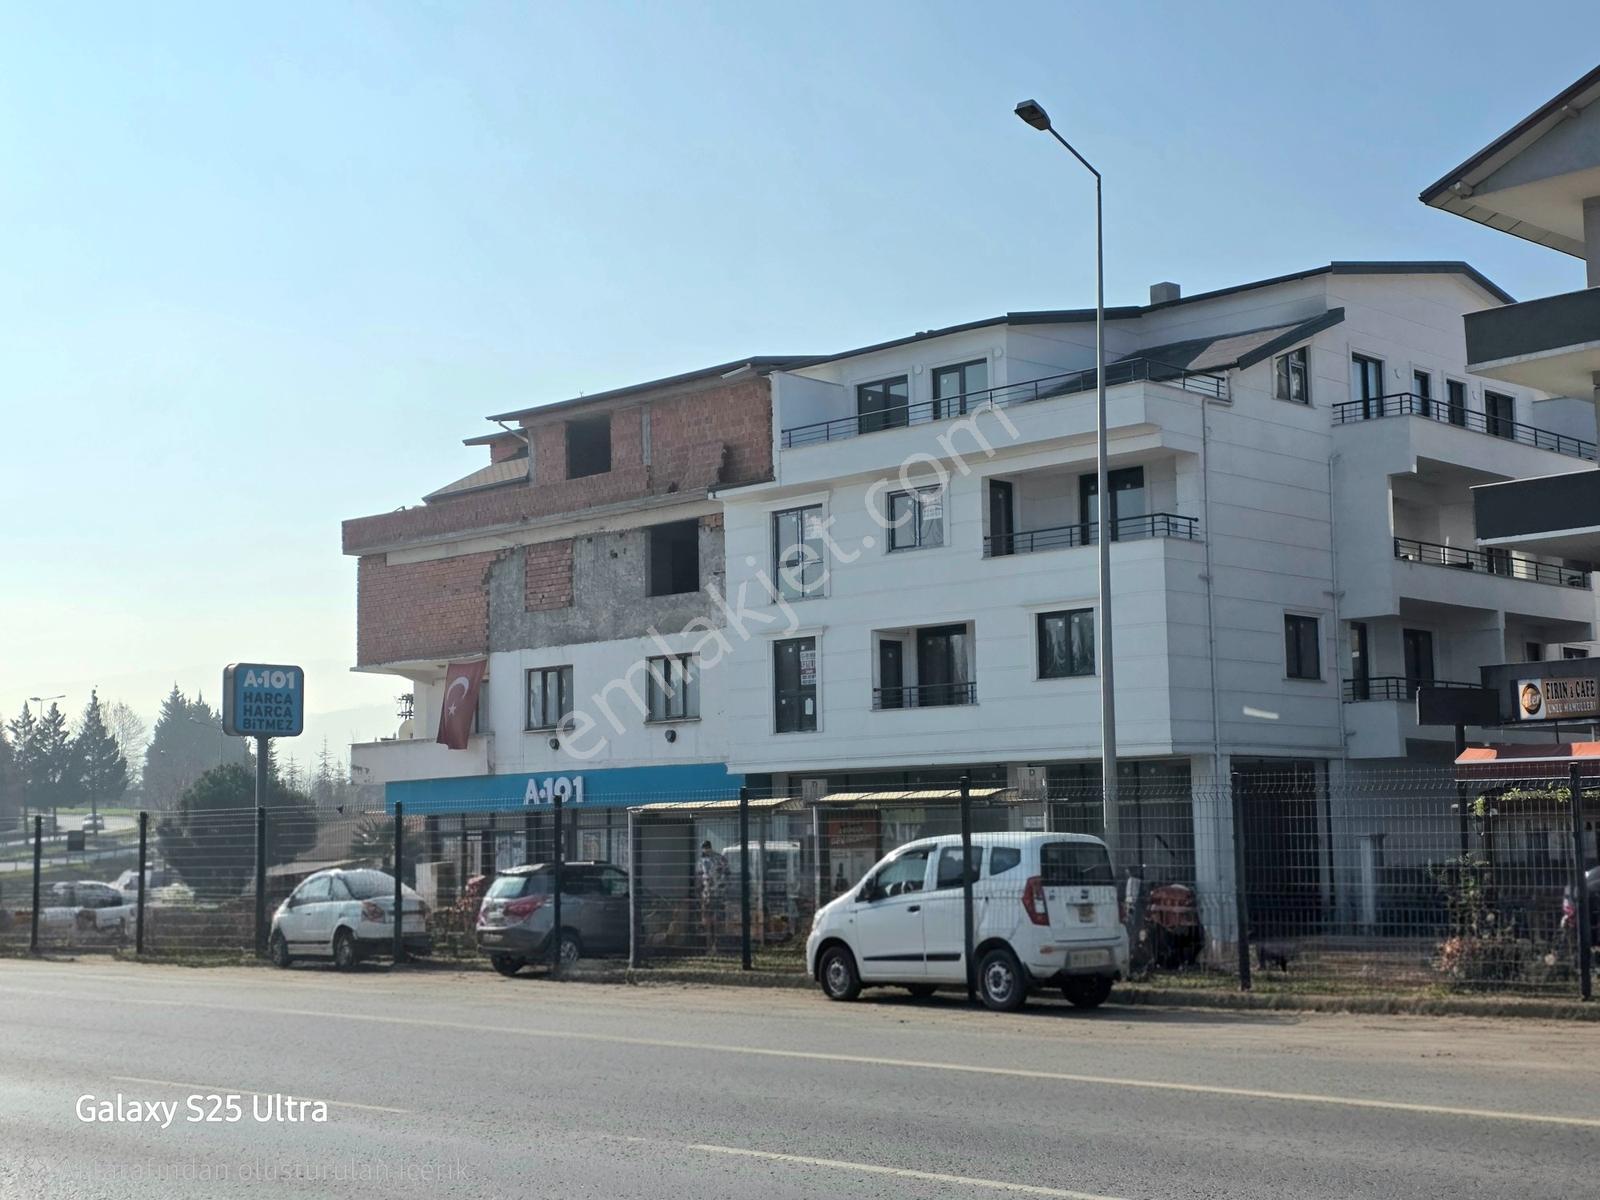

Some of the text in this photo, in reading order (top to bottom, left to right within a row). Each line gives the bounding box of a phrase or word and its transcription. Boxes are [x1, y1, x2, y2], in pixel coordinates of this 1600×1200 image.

[1545, 682, 1568, 699] FIRIN
[1575, 680, 1595, 698] CAFE
[243, 691, 293, 705] HARCA
[243, 705, 293, 718] HARCA
